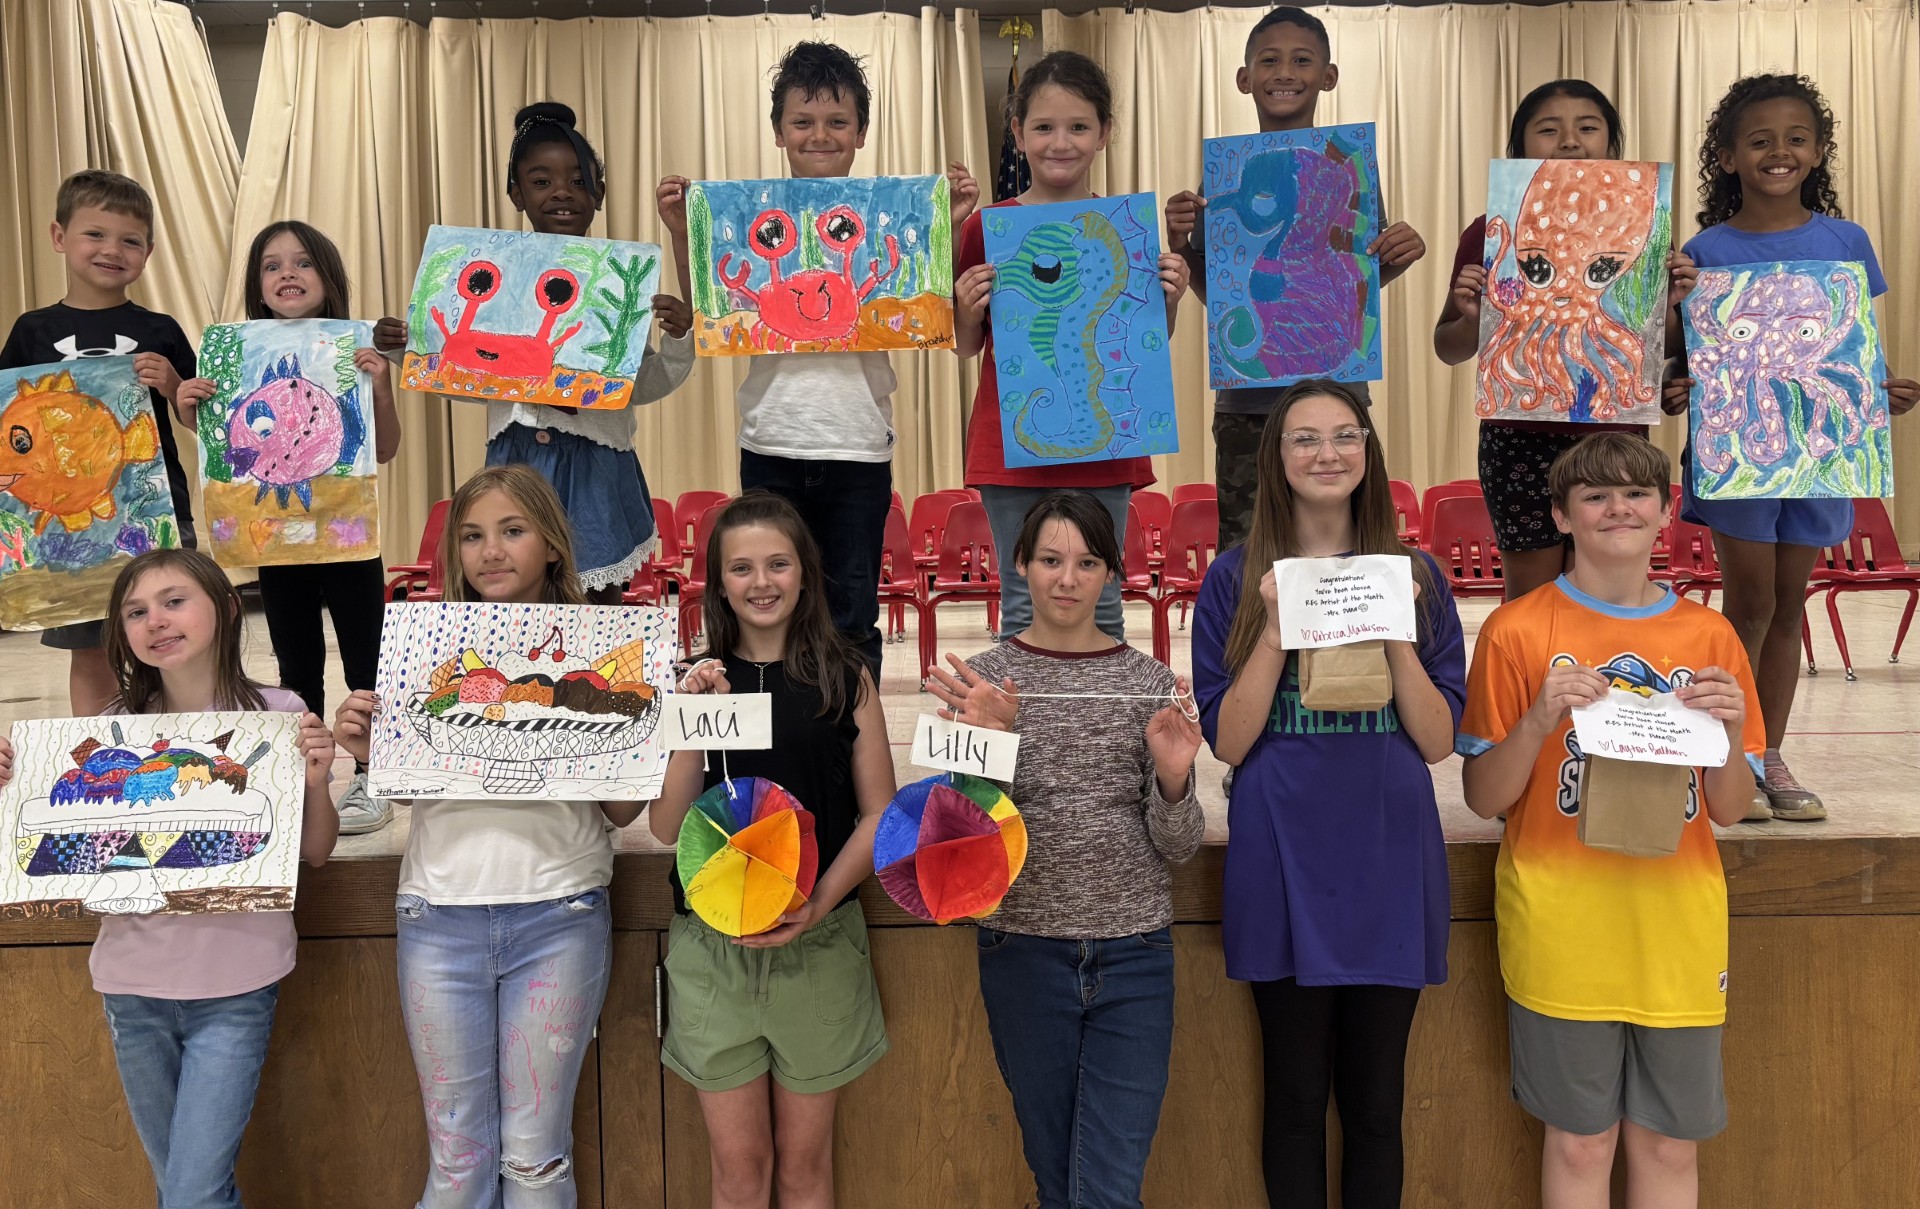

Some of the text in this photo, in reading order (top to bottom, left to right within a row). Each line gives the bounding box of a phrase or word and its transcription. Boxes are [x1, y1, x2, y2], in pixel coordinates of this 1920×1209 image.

[1619, 660, 1631, 673] S
[679, 701, 739, 742] Laci
[928, 725, 988, 775] Lilly
